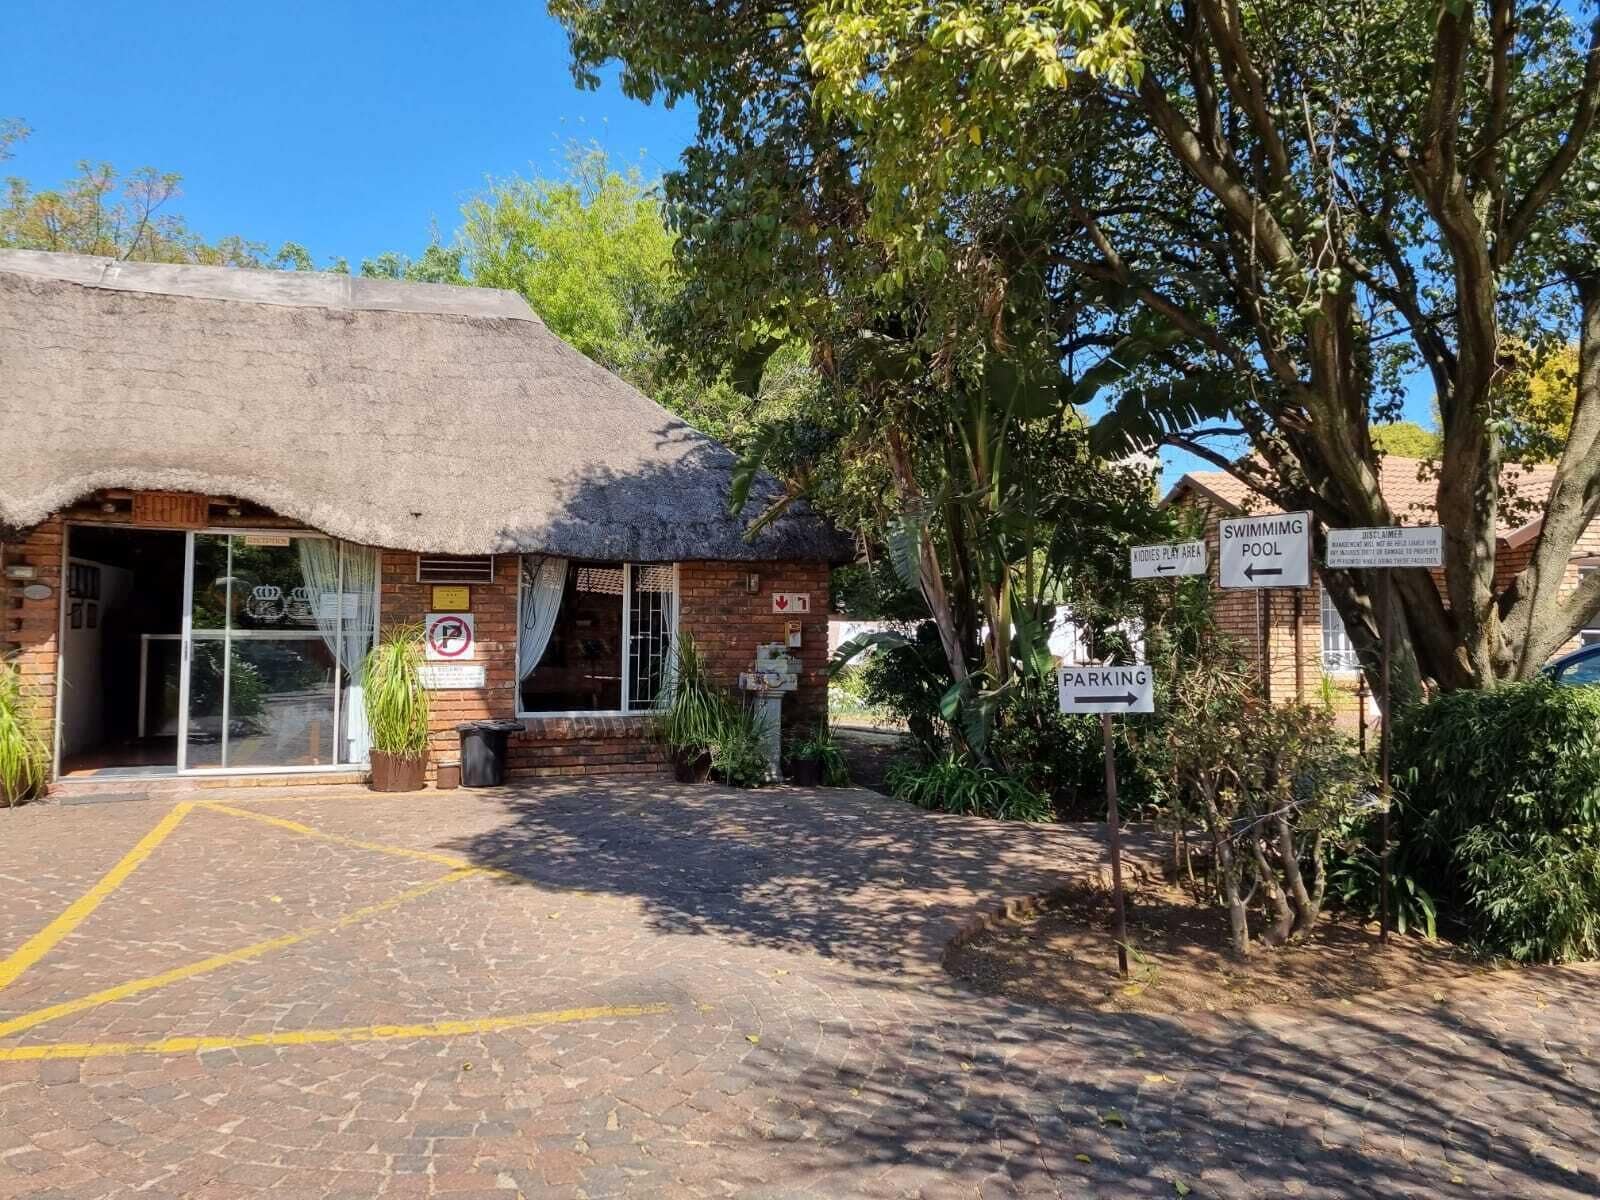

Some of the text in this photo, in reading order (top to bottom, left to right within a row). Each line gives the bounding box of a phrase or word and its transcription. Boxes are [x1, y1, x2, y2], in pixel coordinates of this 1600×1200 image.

[134, 495, 206, 523] RECEPTION
[1224, 520, 1303, 539] SWIMMIMG
[1362, 530, 1403, 540] DISCLAIMER
[1133, 545, 1201, 562] KIDDIES PLAY AREA
[1242, 541, 1282, 557] POOL
[1063, 671, 1146, 687] PARKING
